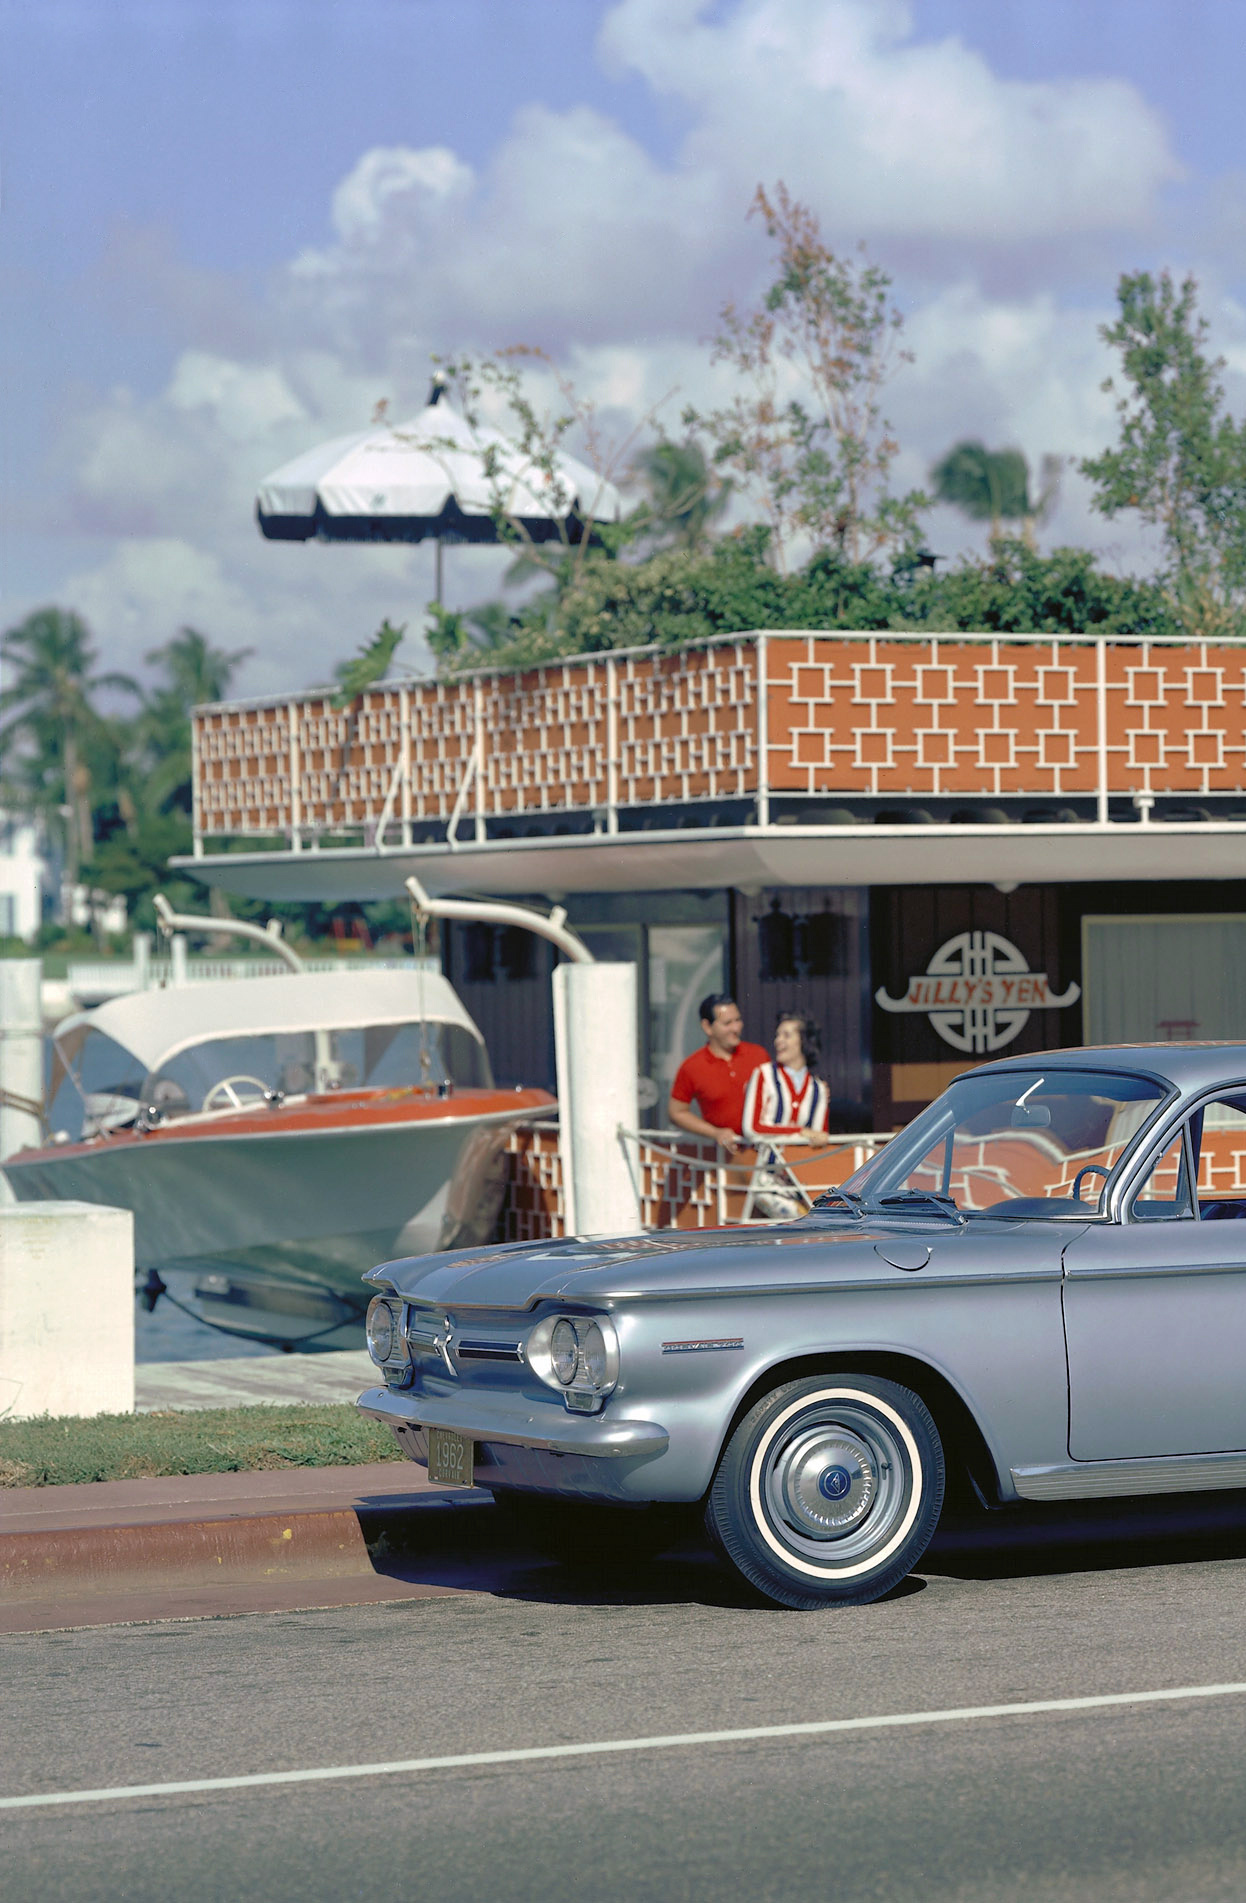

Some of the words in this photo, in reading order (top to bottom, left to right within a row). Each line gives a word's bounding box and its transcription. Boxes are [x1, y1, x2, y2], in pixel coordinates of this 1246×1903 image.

[908, 979, 992, 1005] JILLY'S
[1002, 979, 1048, 1003] YEN
[436, 1441, 464, 1470] 1962
